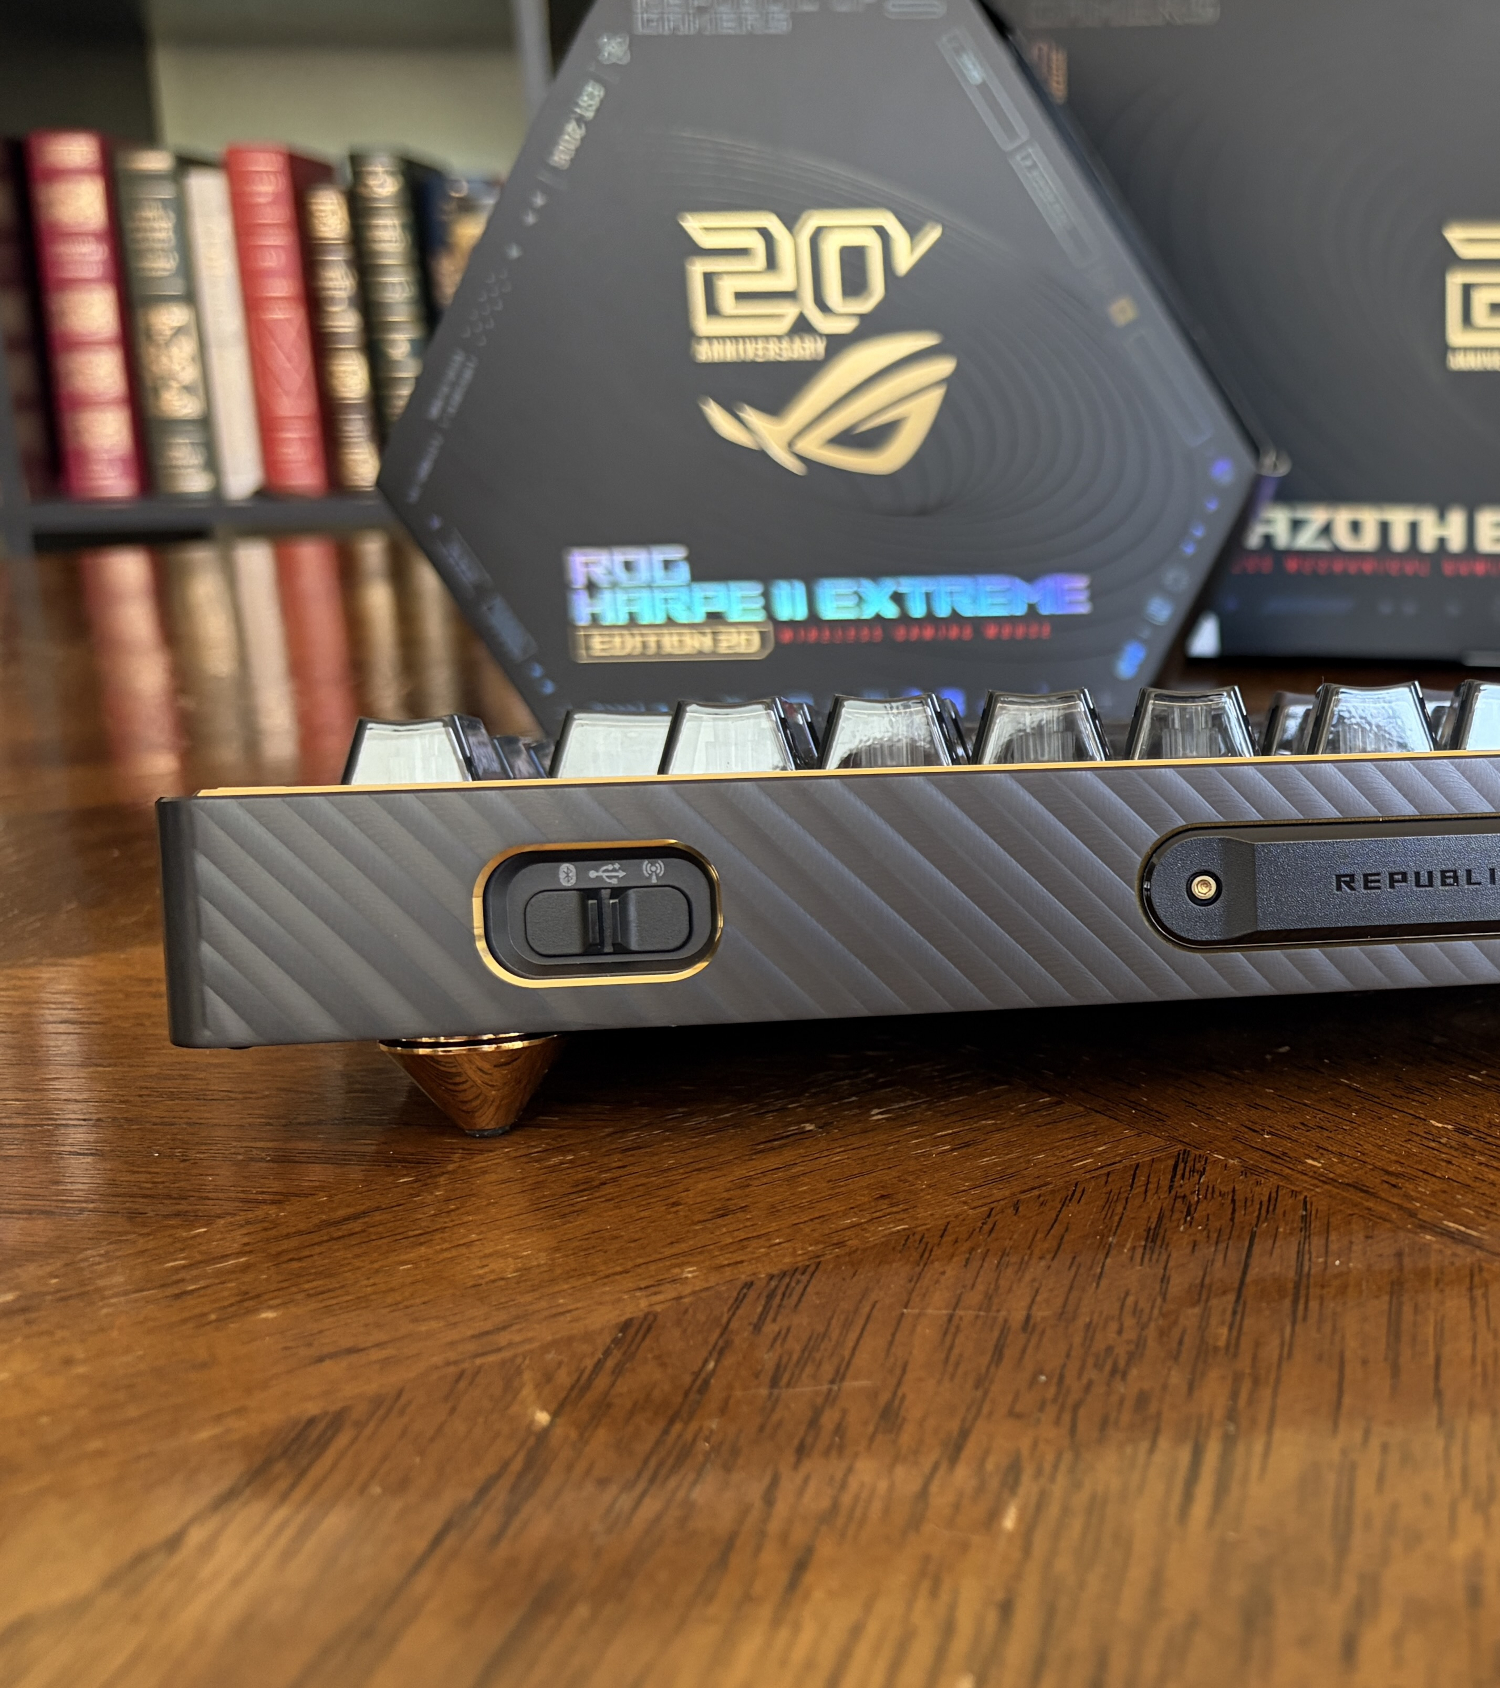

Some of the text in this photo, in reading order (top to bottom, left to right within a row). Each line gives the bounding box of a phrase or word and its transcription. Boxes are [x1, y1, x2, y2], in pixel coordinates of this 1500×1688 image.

[1243, 504, 1468, 554] AZOTH
[563, 544, 692, 589] ROG
[567, 571, 1093, 627] HARPE II EXTREME
[586, 624, 762, 657] EDITION 20
